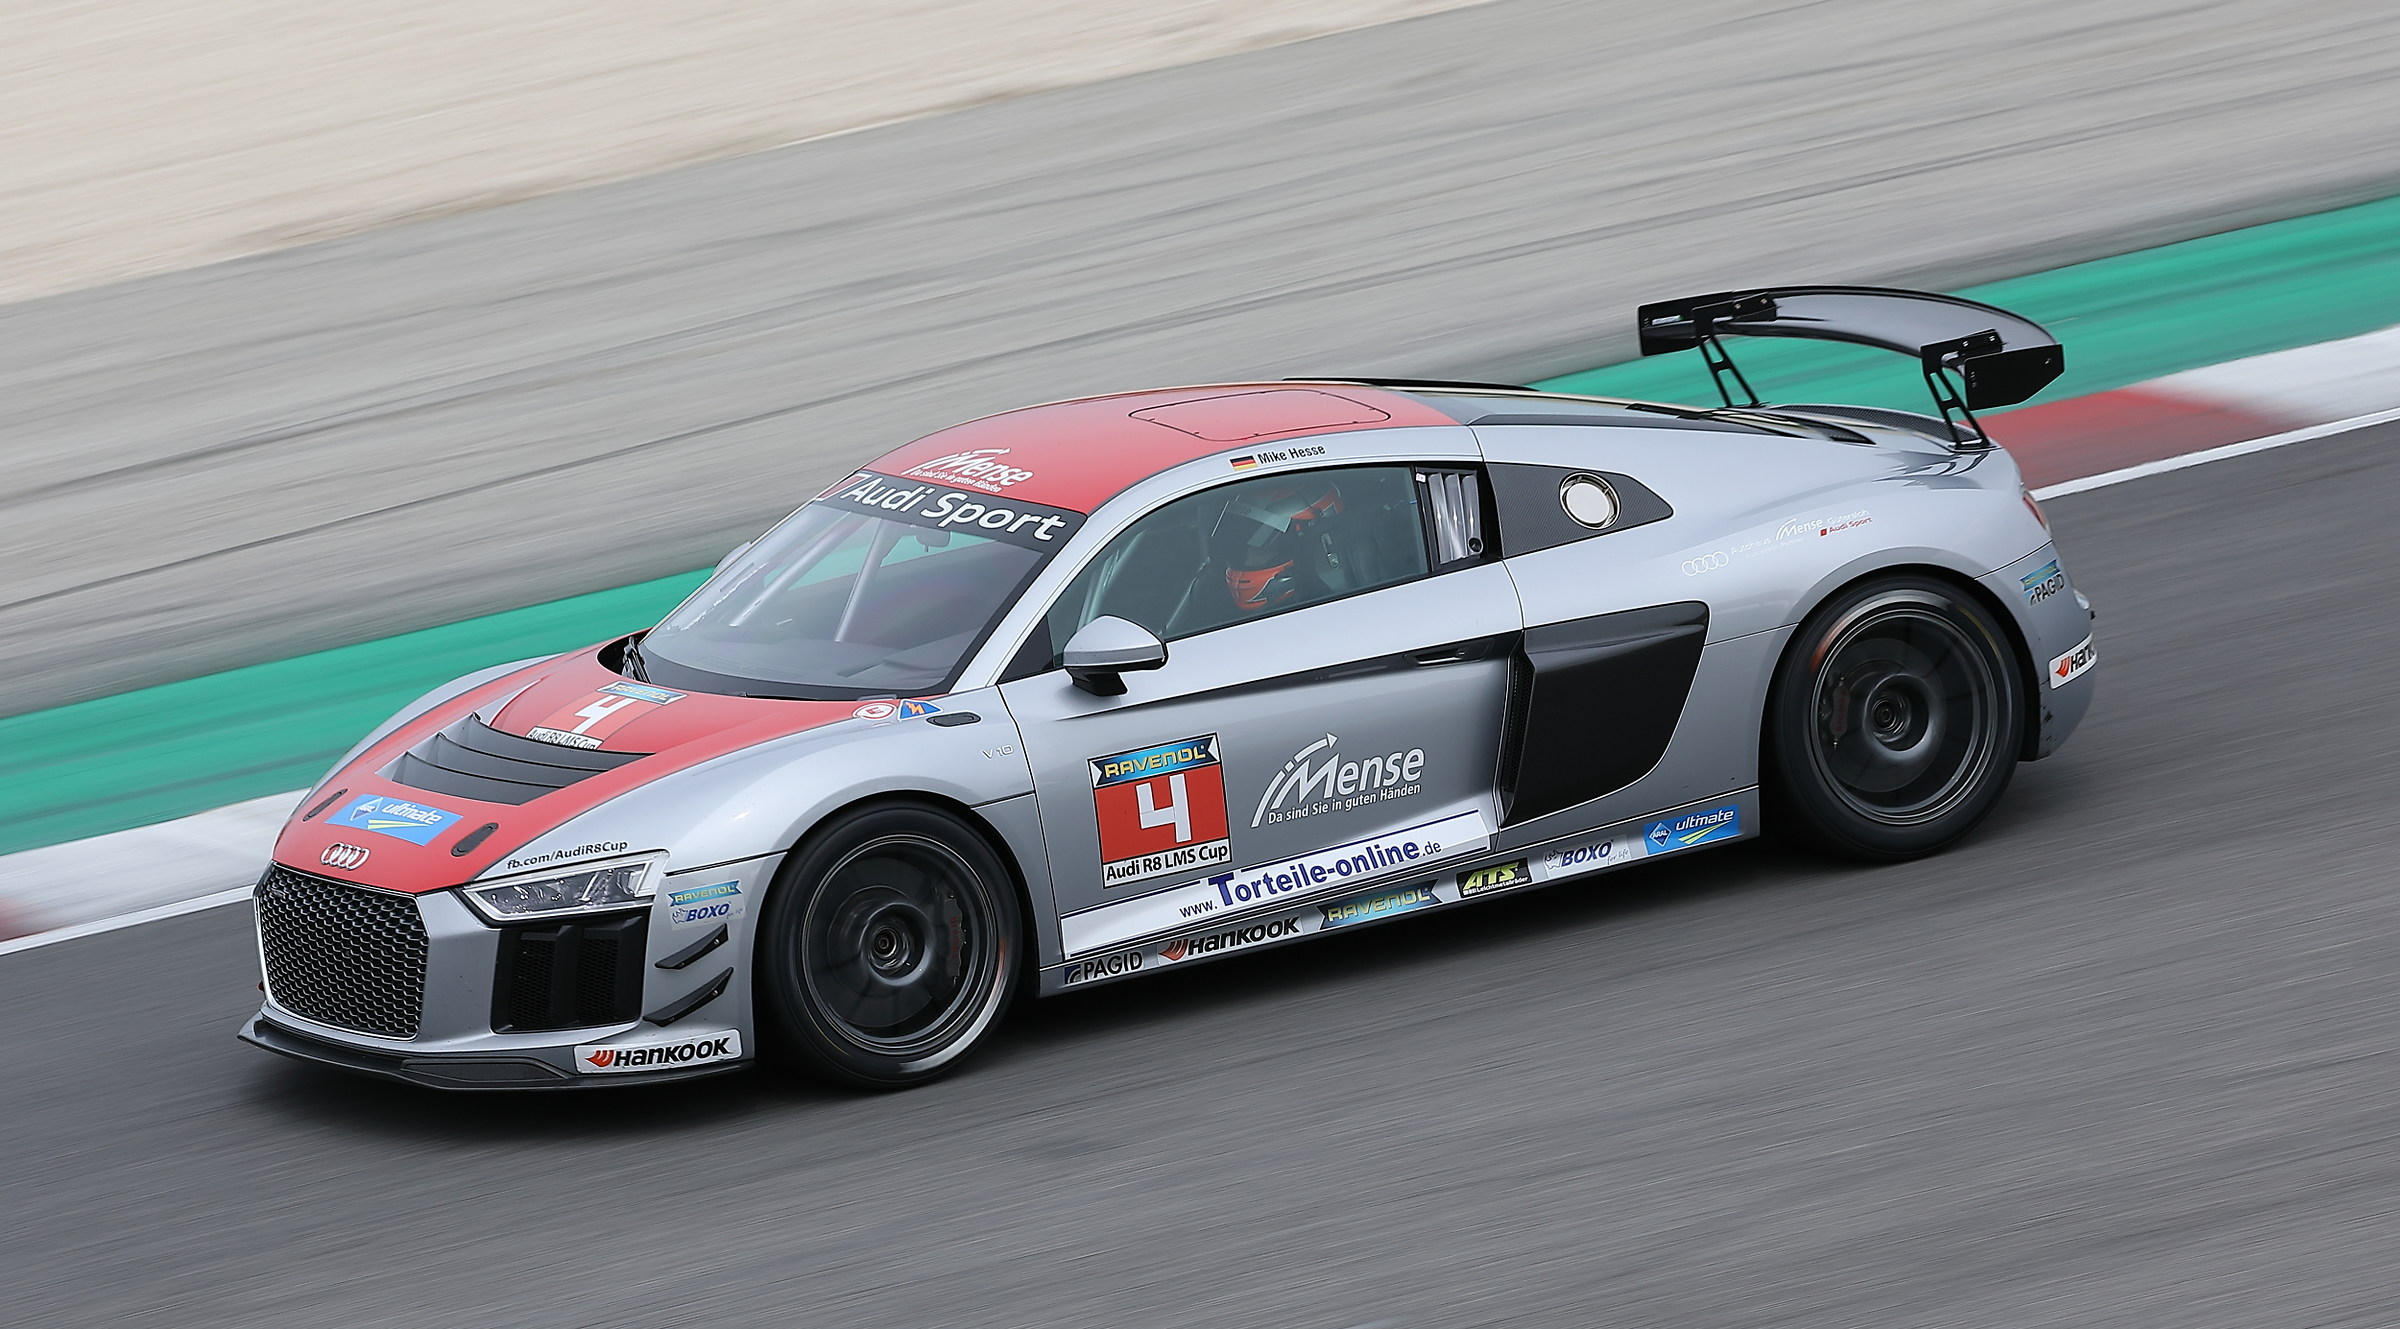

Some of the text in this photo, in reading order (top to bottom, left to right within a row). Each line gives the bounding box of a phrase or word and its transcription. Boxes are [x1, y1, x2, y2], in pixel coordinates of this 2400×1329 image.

[1257, 445, 1326, 465] Mike Hesse
[920, 453, 1034, 487] Mense
[840, 477, 1067, 541] Audi Sport
[1778, 518, 1823, 541] Mense
[1829, 517, 1873, 534] Audi Sport
[2034, 573, 2065, 602] PAGID
[570, 695, 638, 735] 4
[982, 744, 1014, 760] V10
[1104, 746, 1206, 778] RAVENOL
[1268, 746, 1426, 810] Mense
[381, 802, 444, 825] ultimate
[1135, 773, 1192, 843] 4
[1268, 783, 1421, 824] Da sind Sie in guten Händen
[1652, 829, 1668, 839] ARAL
[1675, 809, 1734, 831] ultimate
[507, 841, 628, 870] fb.com/AudiR8Cup
[1106, 845, 1228, 881] Audi R8 LMS Cup
[1561, 840, 1613, 868] BOXO
[1606, 849, 1629, 866] for life
[1463, 862, 1519, 891] ATS
[674, 885, 736, 902] RAVENOL
[1327, 888, 1431, 922] RAVENOL
[686, 903, 730, 922] BOXO
[1083, 951, 1143, 981] PAGID
